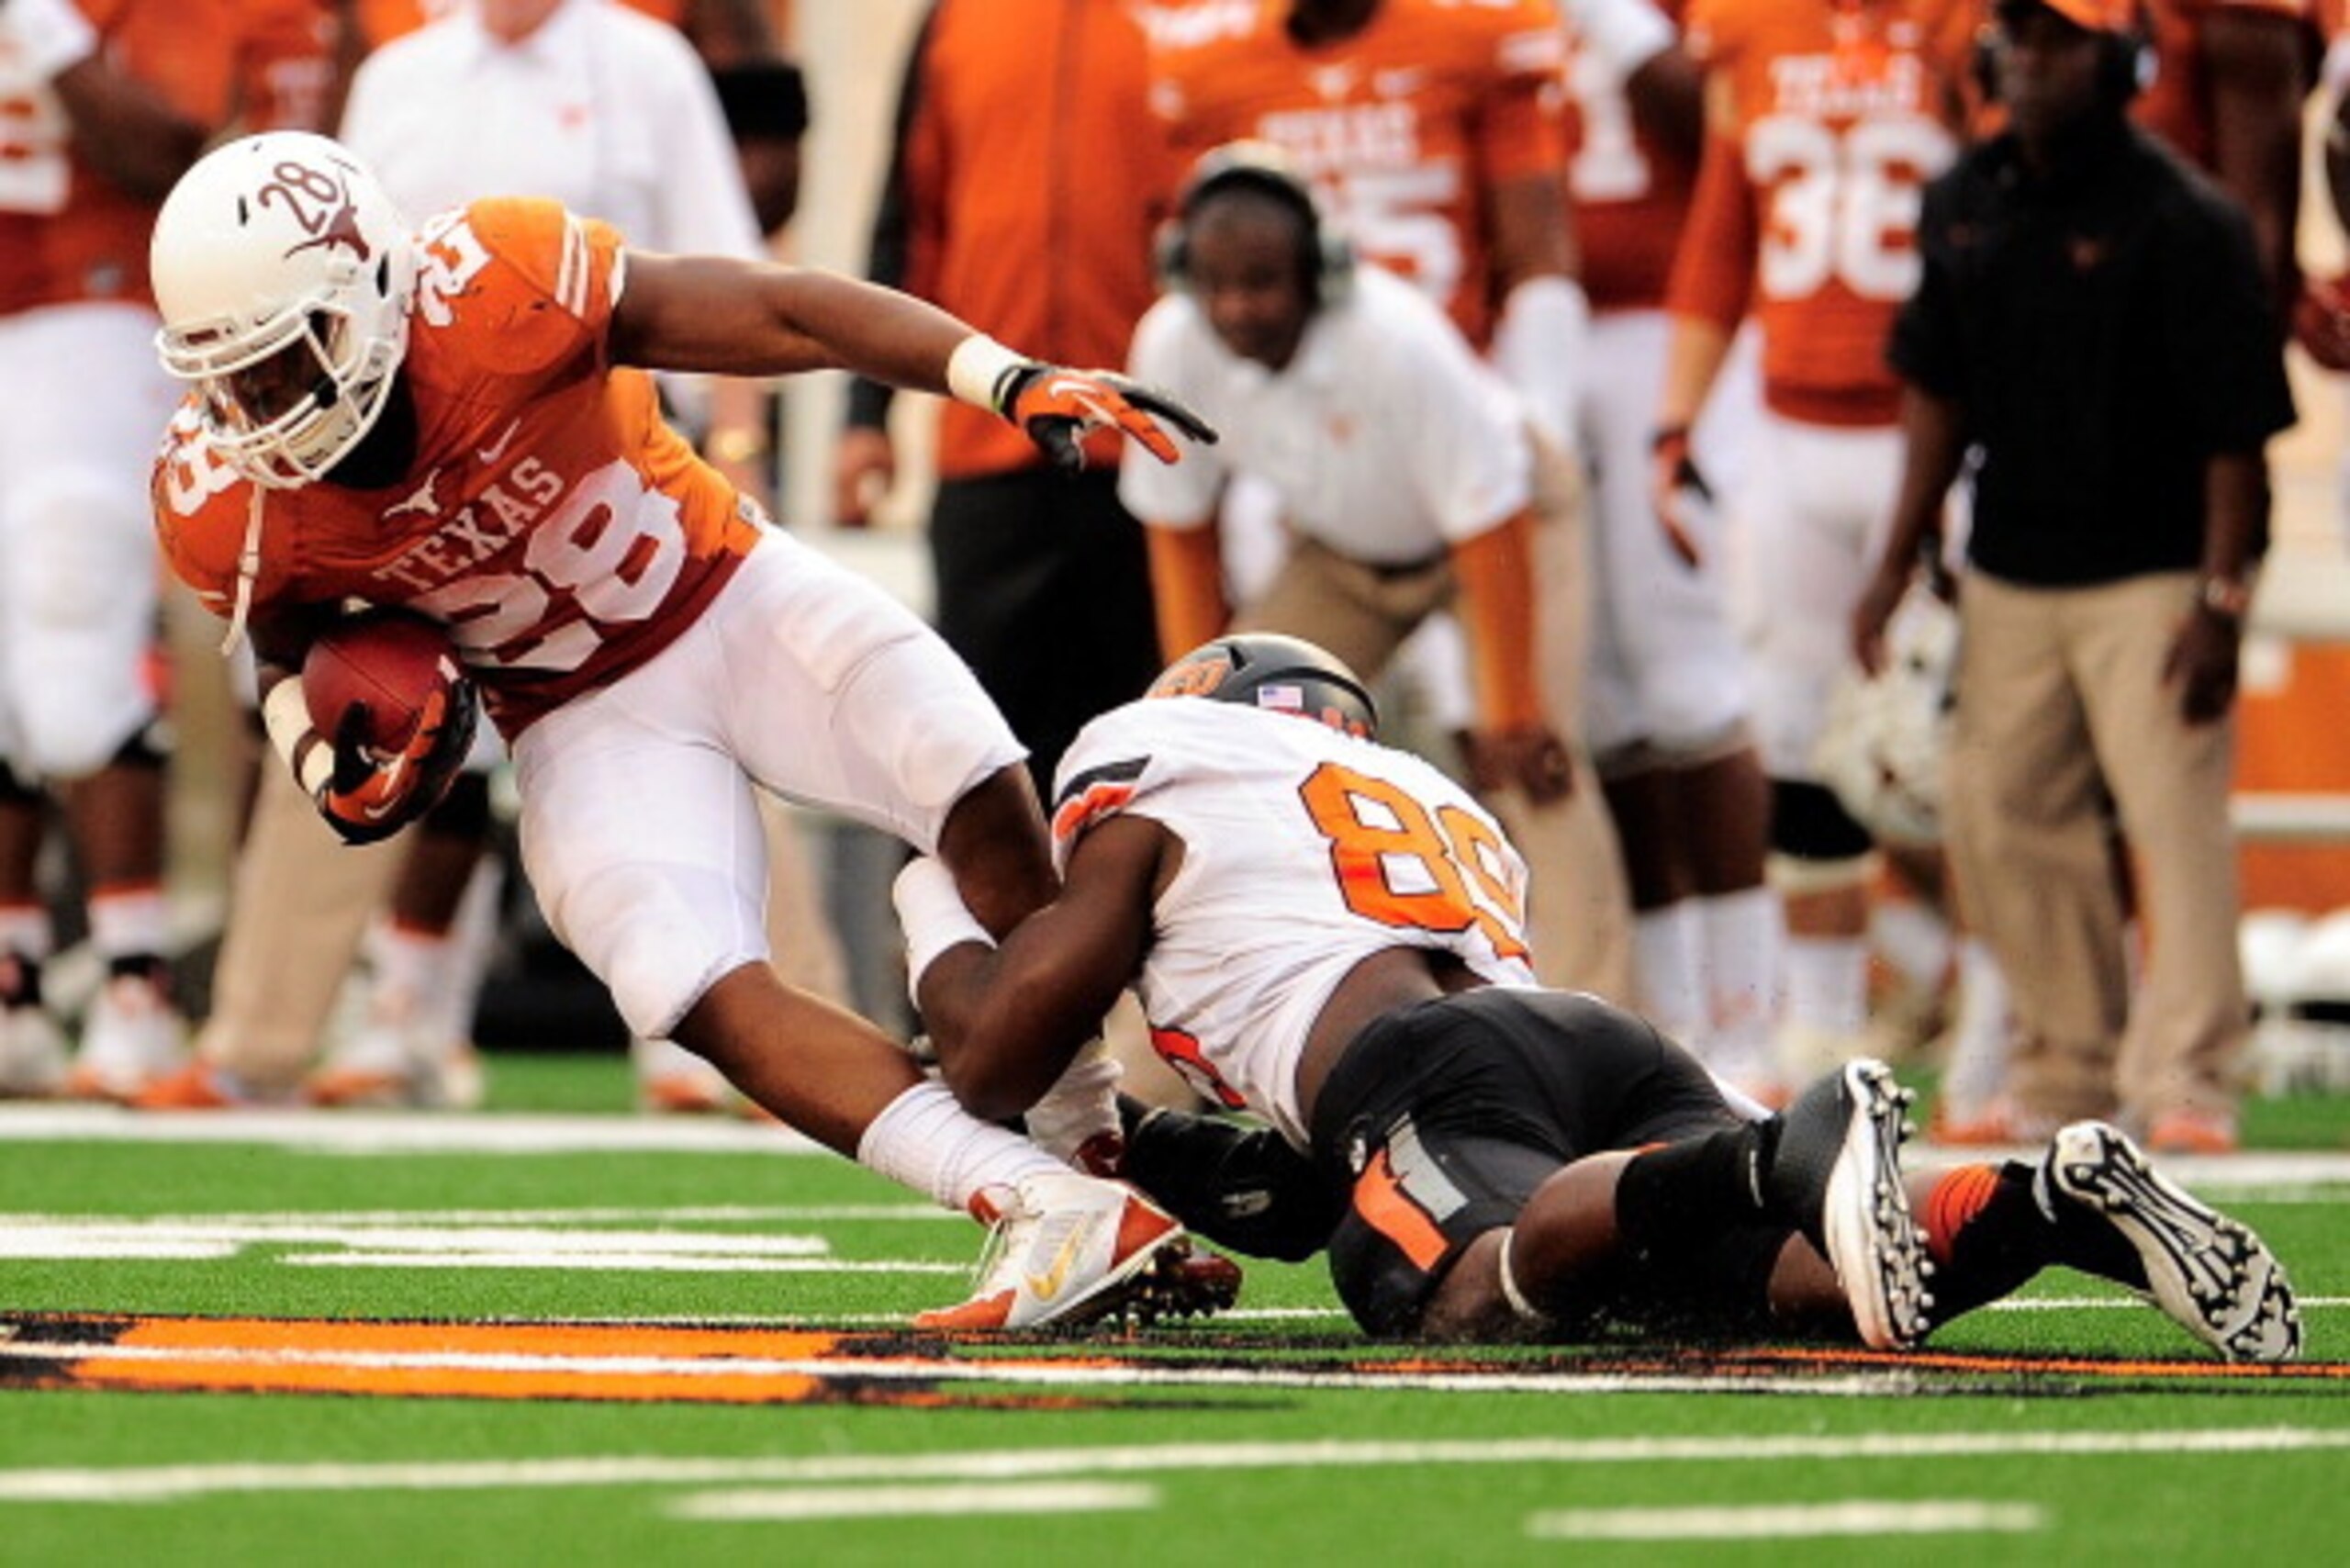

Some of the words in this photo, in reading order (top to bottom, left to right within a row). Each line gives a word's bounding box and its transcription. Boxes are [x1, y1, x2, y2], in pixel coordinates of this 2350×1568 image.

[258, 162, 338, 235] 28
[1746, 116, 1959, 301] 36
[372, 456, 564, 590] TEXAS
[408, 456, 687, 671] 28
